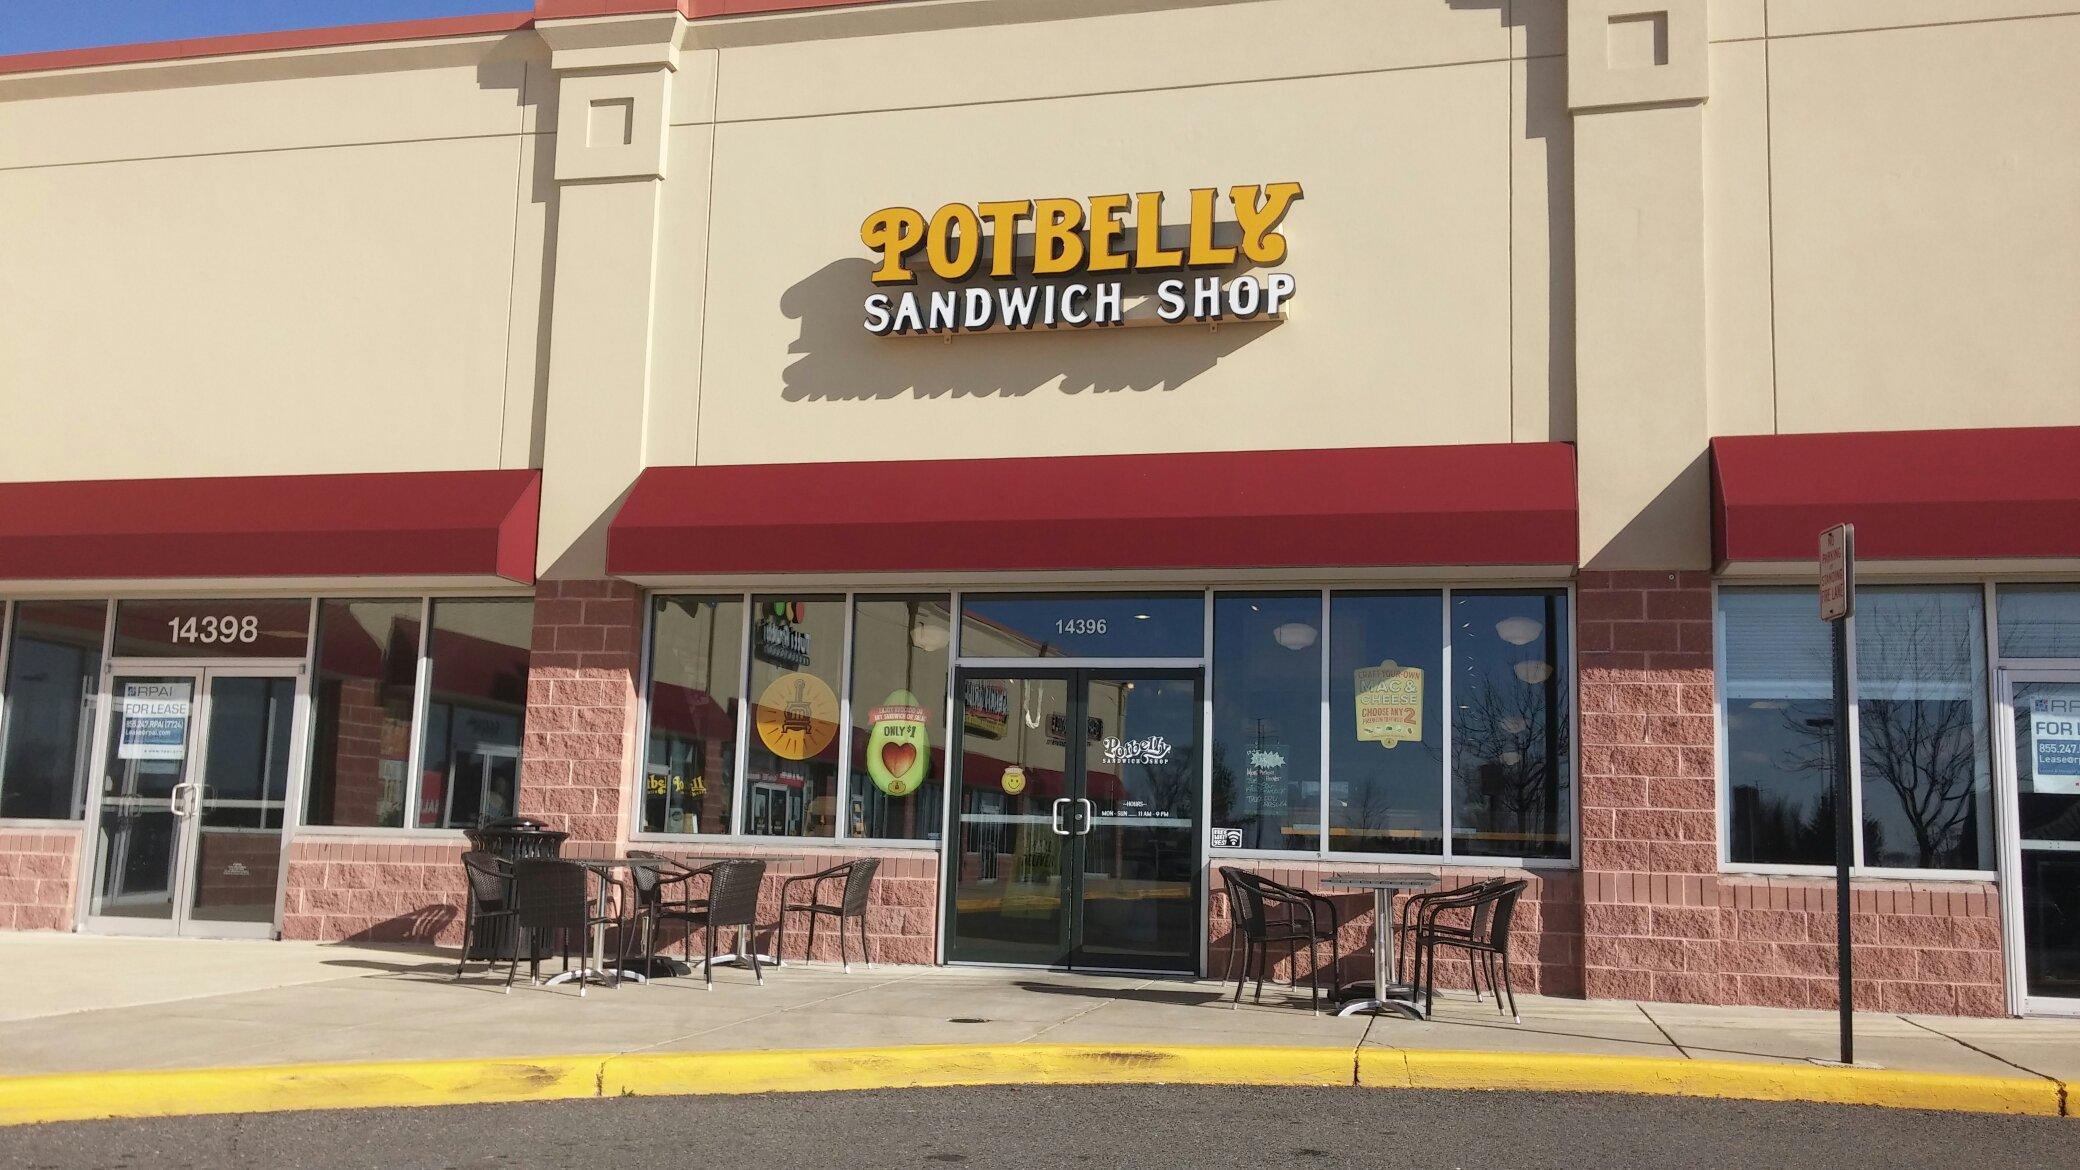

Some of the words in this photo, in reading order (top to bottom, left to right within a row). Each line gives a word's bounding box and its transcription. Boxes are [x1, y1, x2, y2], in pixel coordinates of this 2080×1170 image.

[861, 182, 1303, 285] POTBELLY
[864, 281, 1122, 334] SANDWICH
[1157, 273, 1296, 321] SHOP
[168, 615, 258, 643] 14398
[1055, 619, 1107, 634] 14396
[138, 686, 173, 697] RPAI
[1360, 680, 1401, 693] MAC
[1404, 680, 1417, 693] &
[1361, 694, 1417, 705] CHEESE
[126, 703, 149, 714] FOR
[151, 703, 187, 714] LEASE
[1361, 707, 1390, 717] CHOOSE
[1391, 707, 1403, 716] ANY
[1404, 707, 1416, 725] 2
[884, 726, 906, 737] ONLY
[907, 725, 916, 738] $1
[2036, 721, 2073, 735] FOR
[1103, 736, 1171, 764] Potbelly
[2039, 743, 2080, 754] 855.247.
